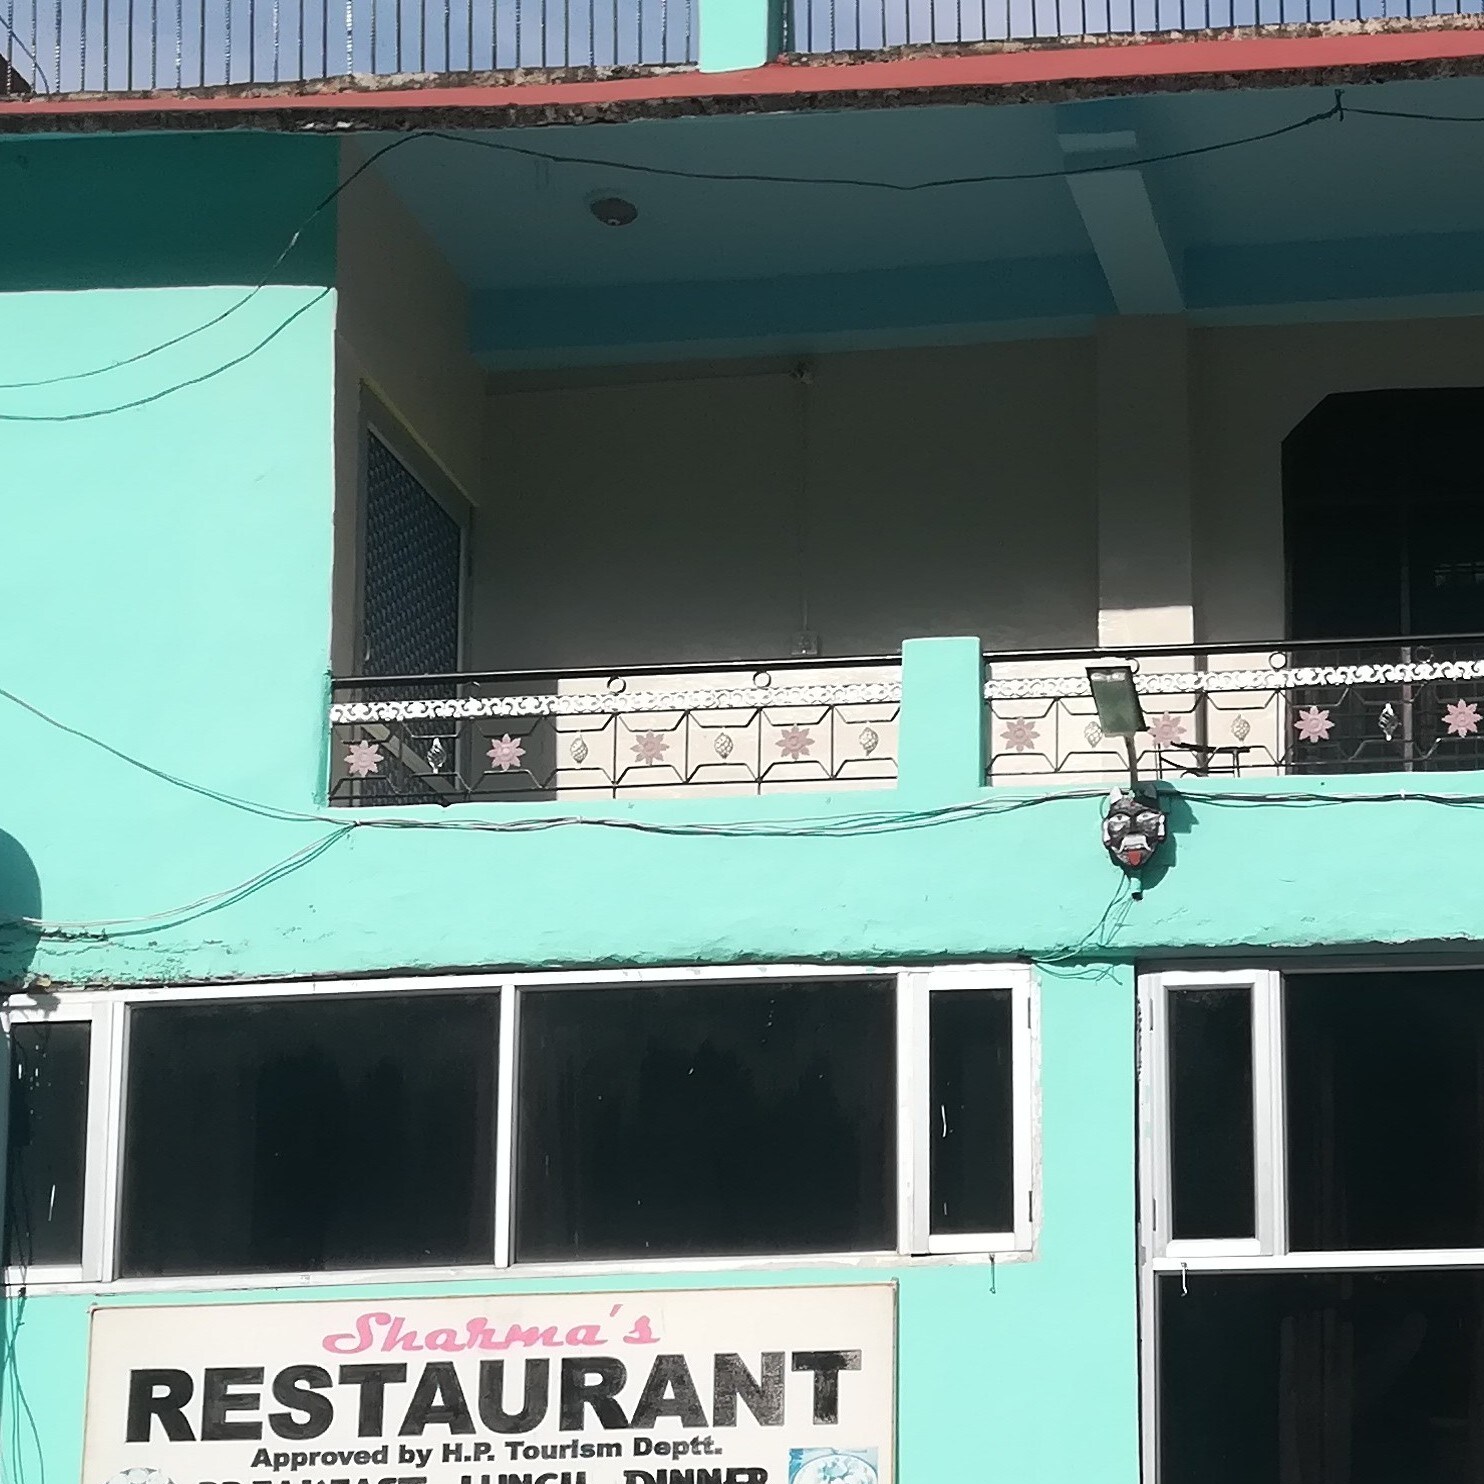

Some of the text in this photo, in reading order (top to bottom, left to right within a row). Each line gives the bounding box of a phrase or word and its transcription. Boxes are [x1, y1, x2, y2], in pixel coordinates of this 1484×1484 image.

[322, 1305, 661, 1355] Sharma's
[125, 1350, 862, 1443] RESTAURANT
[250, 1434, 723, 1472] Approved by H.P. Tourism Deptt.
